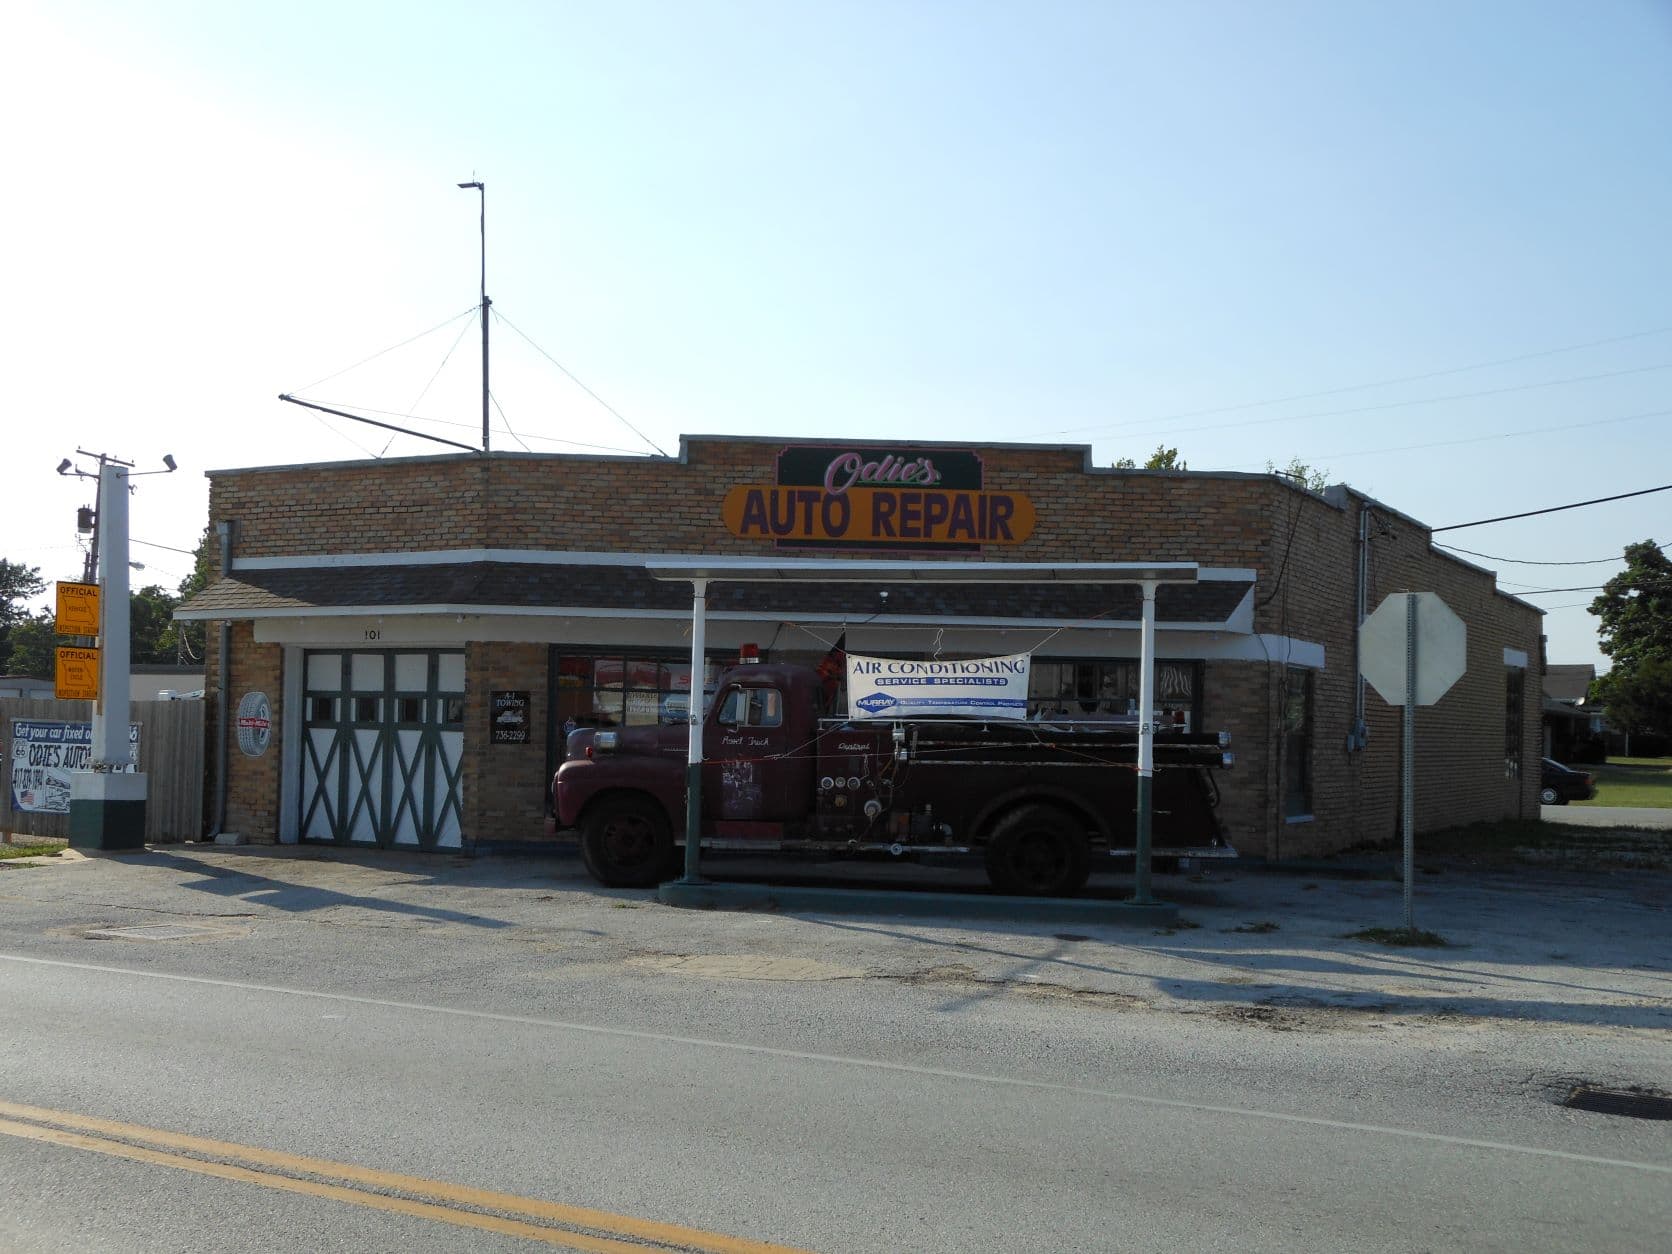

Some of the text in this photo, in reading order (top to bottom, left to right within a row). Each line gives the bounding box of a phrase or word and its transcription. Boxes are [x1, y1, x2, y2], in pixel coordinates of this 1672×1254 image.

[824, 452, 941, 495] Odie's
[740, 489, 1014, 540] AUTO REPAIR
[60, 586, 97, 597] OFFICIAL
[365, 630, 380, 641] 101
[60, 651, 97, 660] OFFICIAL
[853, 659, 1025, 674] AIR CONDITIONING
[496, 699, 525, 707] TOWING
[857, 699, 896, 707] MURRAY
[15, 723, 30, 737] Get
[29, 726, 48, 741] your
[49, 729, 62, 739] car
[63, 725, 84, 742] fixed
[29, 743, 61, 767] ODIE'S
